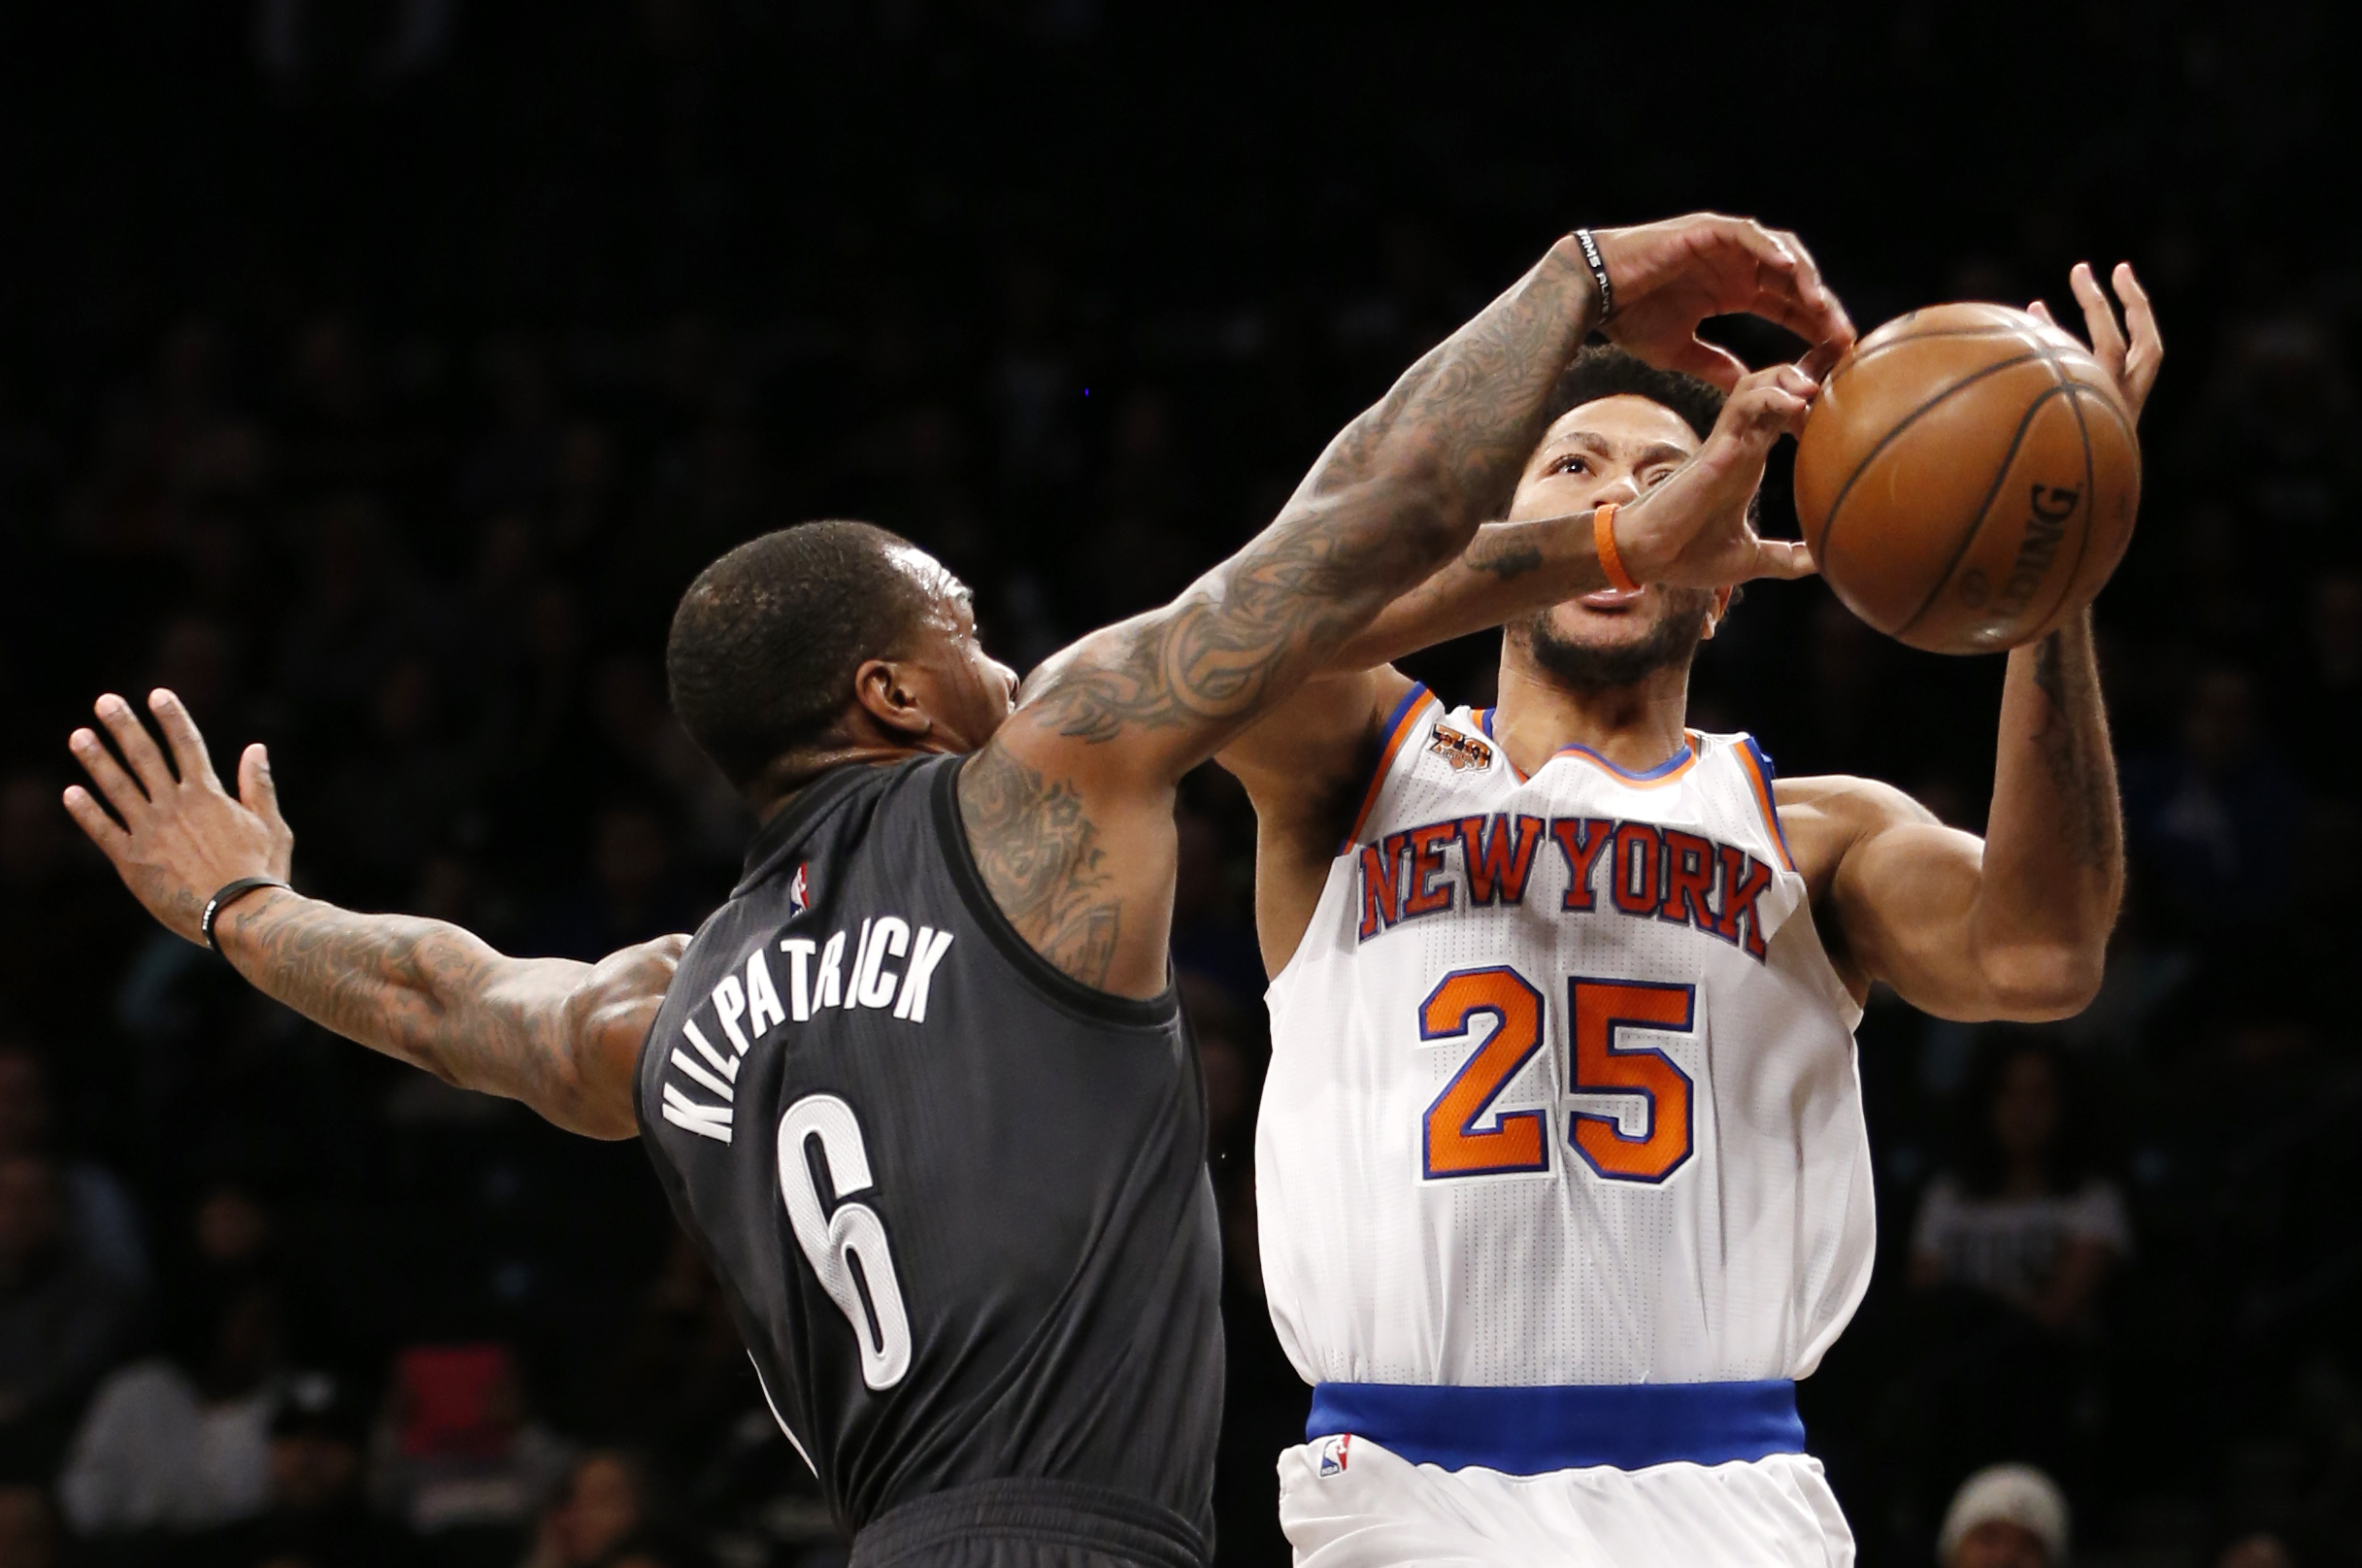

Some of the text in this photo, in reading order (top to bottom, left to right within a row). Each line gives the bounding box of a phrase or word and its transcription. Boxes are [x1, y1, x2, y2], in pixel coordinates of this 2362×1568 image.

[1359, 812, 1773, 965] NEW YORK
[661, 915, 955, 1145] KILPATRICK
[1417, 964, 1696, 1184] 25
[777, 1092, 913, 1392] 6
